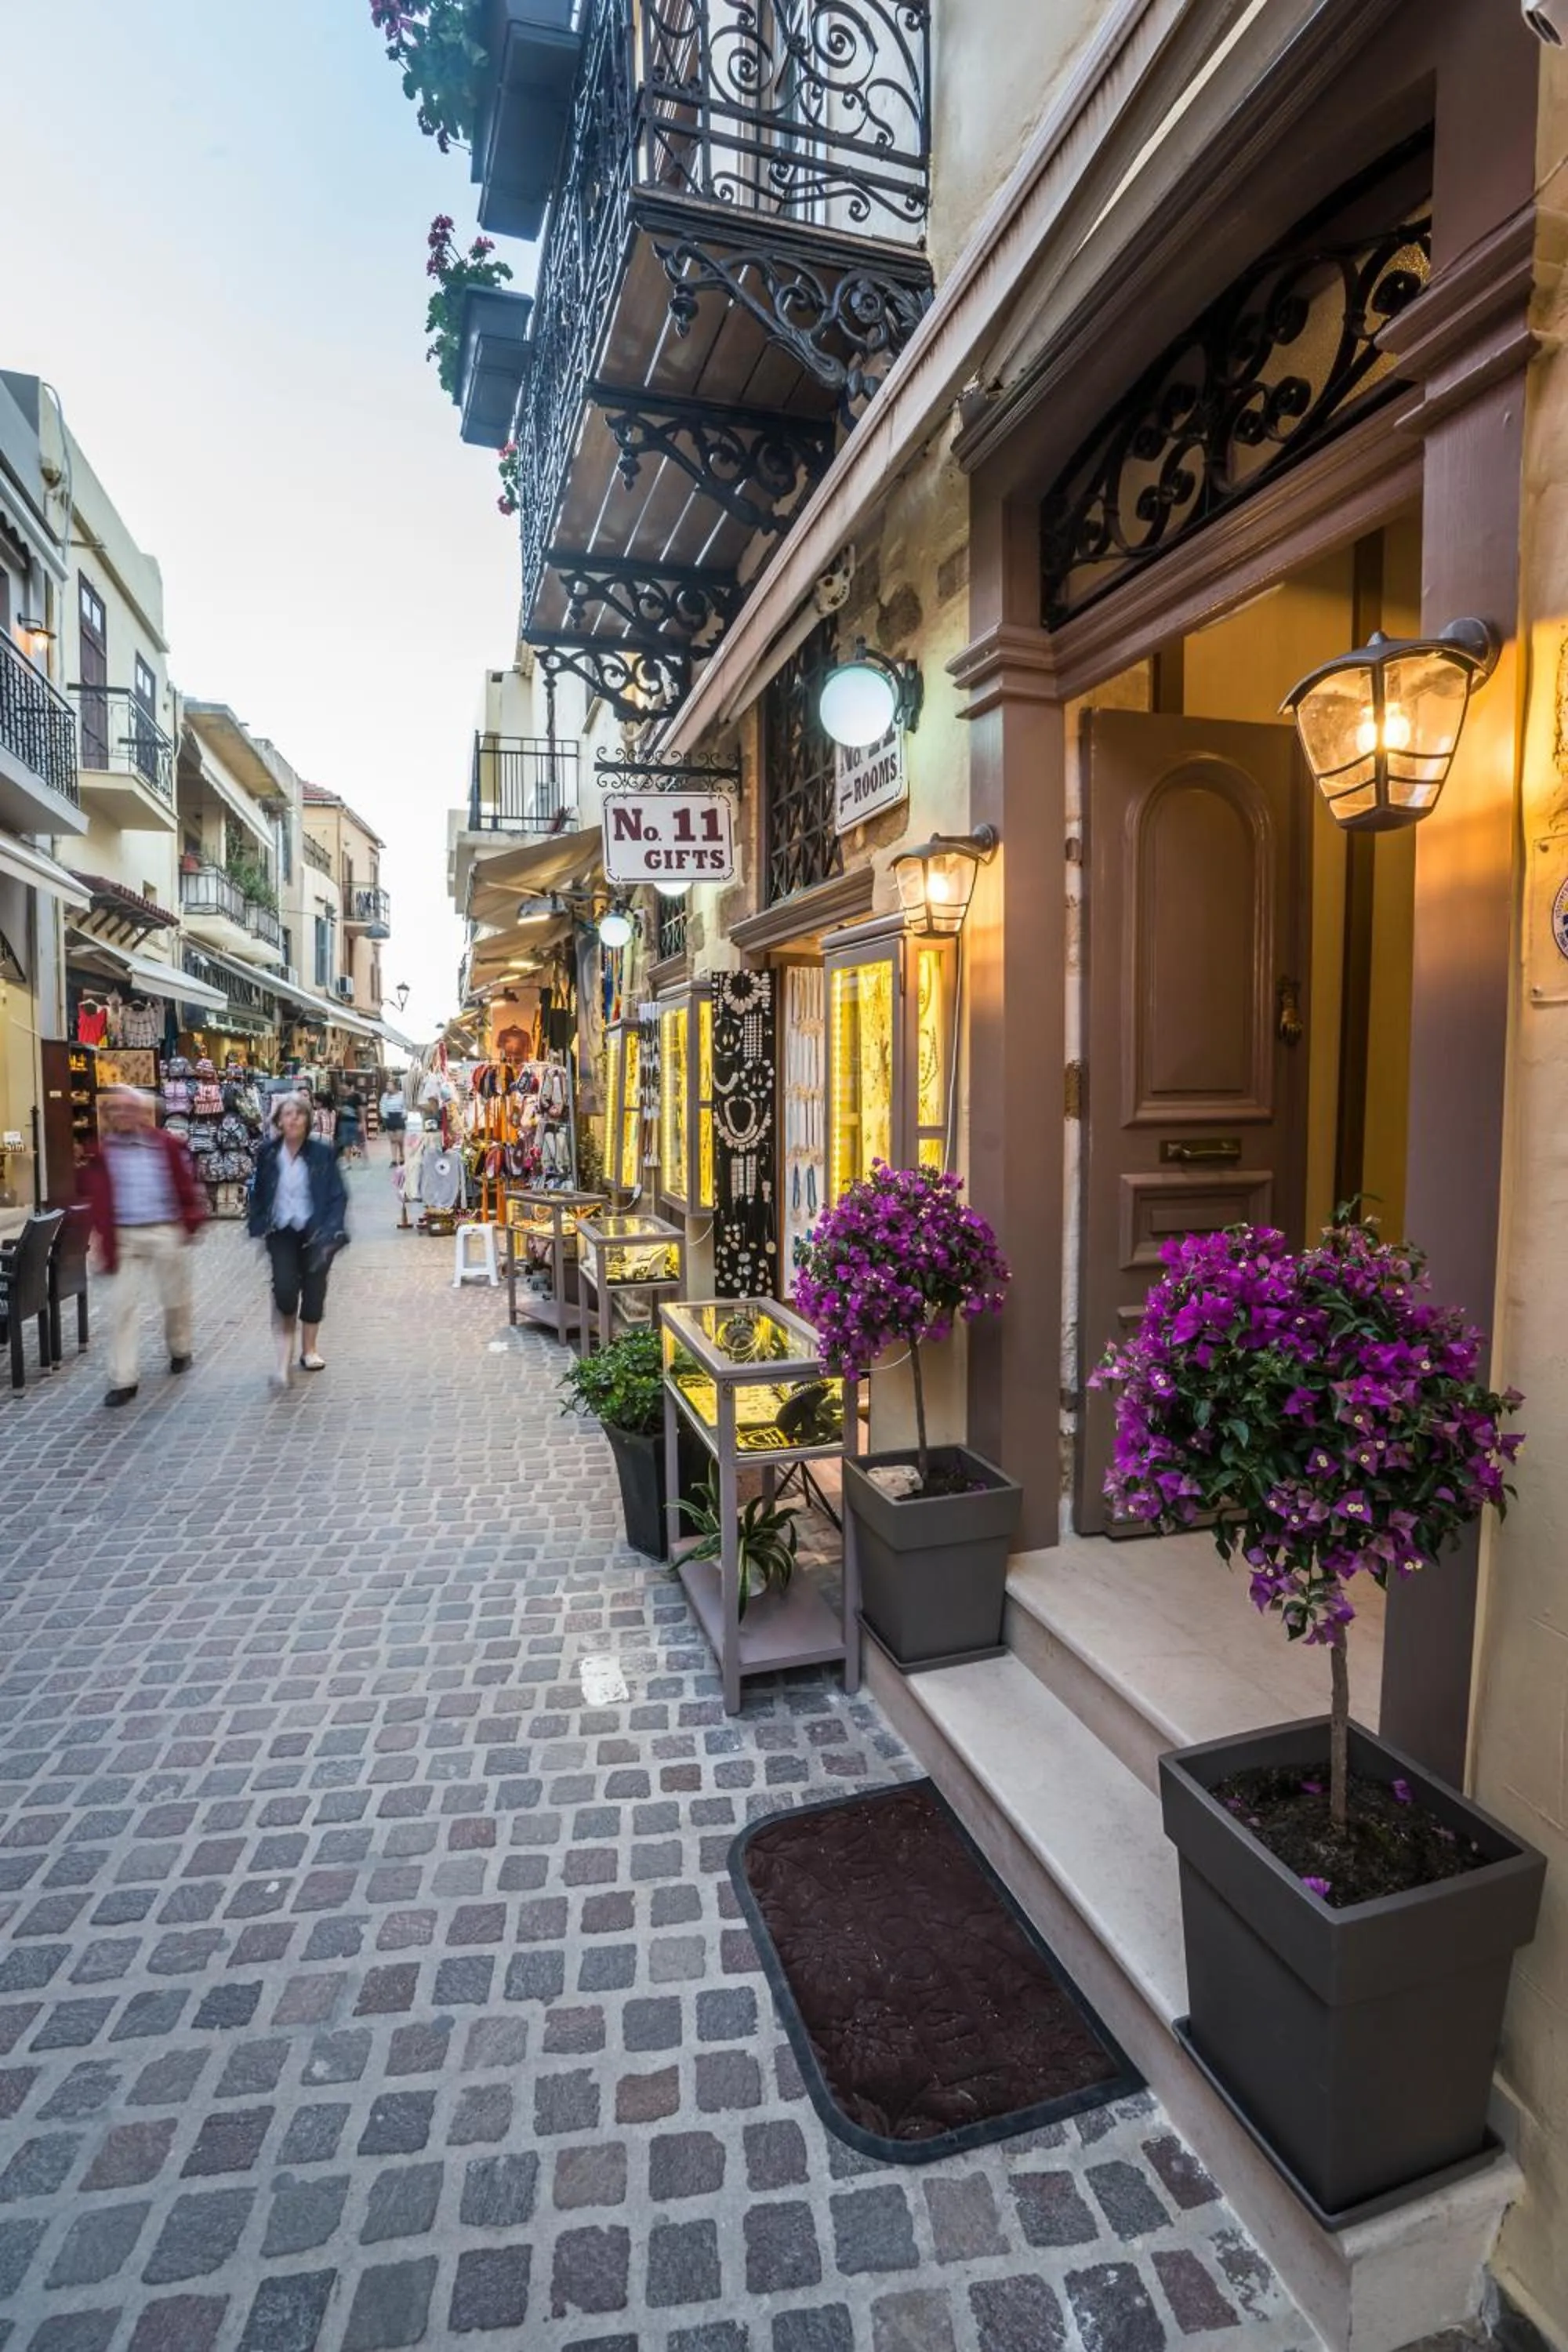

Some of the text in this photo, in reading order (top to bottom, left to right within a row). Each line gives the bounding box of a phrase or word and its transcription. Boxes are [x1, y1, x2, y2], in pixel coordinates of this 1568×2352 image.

[854, 752, 897, 804] ROOMS
[612, 808, 724, 841] No. 11
[644, 849, 725, 869] GIFTS
